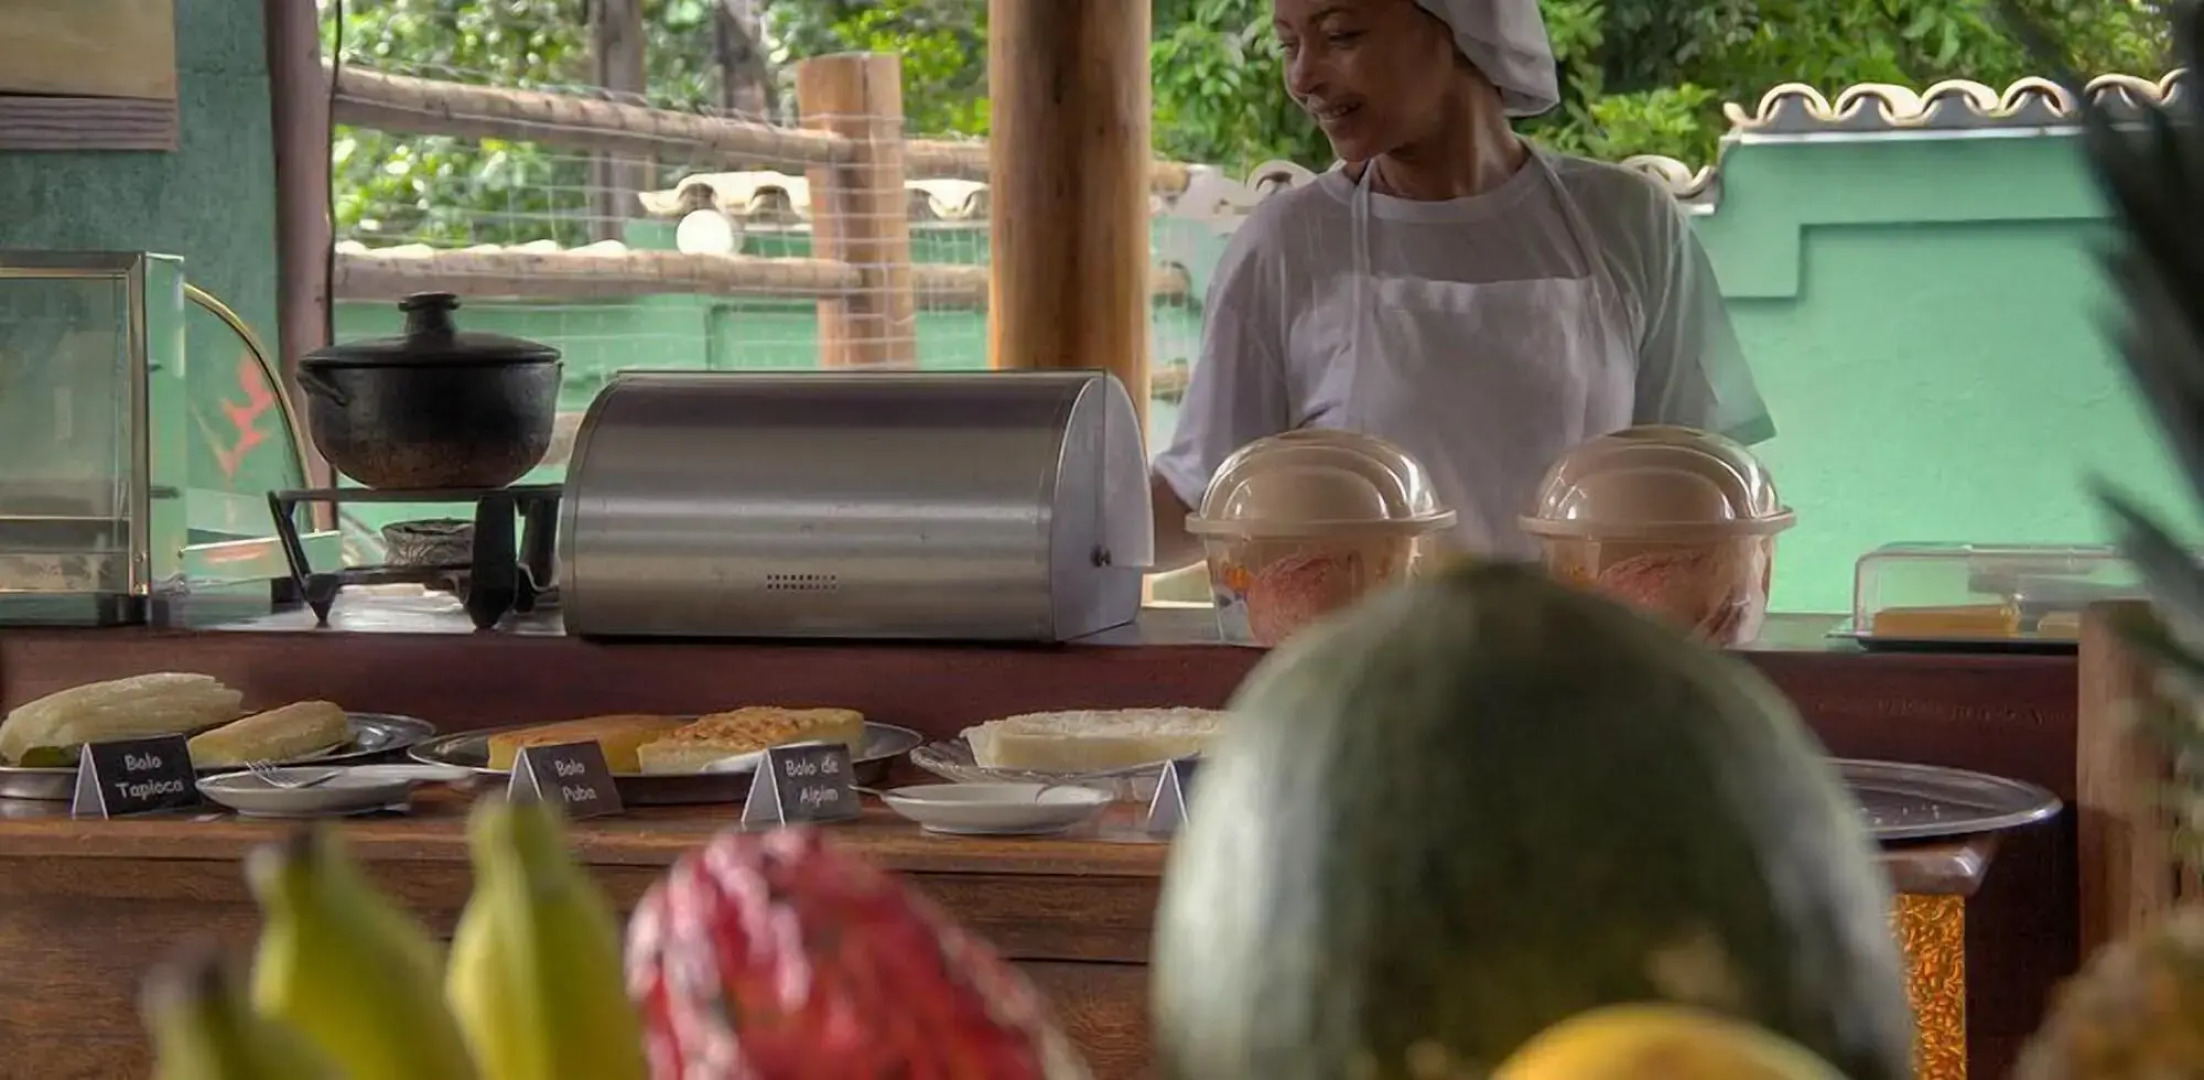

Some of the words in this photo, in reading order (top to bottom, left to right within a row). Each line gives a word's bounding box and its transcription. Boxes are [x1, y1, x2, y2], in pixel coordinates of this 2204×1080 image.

[124, 752, 162, 771] Bolo
[554, 758, 586, 776] Bolo
[785, 758, 817, 777] Bolo
[821, 755, 840, 774] de
[115, 780, 184, 800] Tapioca
[562, 785, 598, 802] Puba
